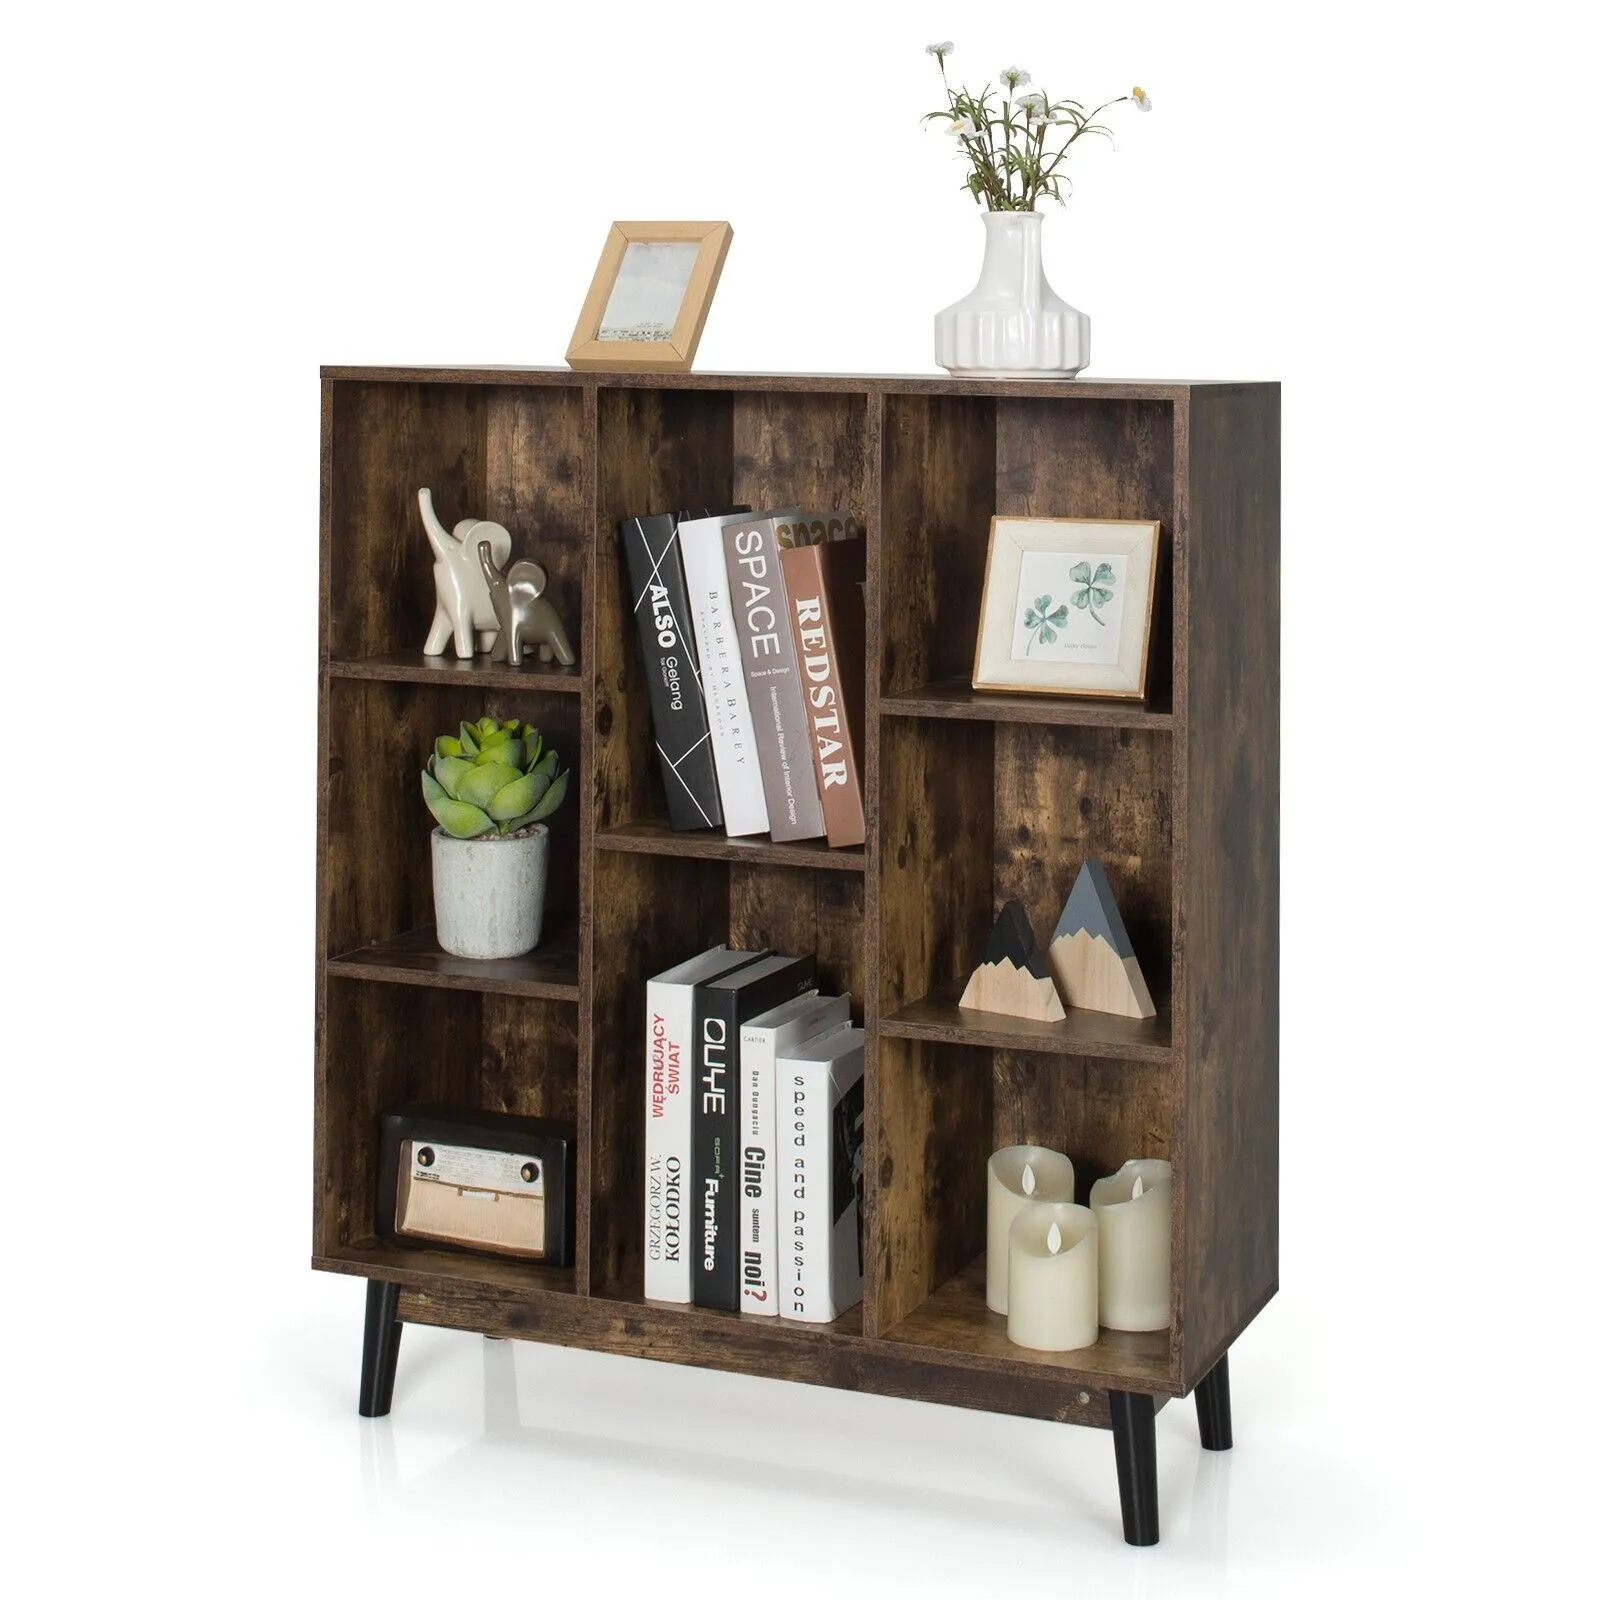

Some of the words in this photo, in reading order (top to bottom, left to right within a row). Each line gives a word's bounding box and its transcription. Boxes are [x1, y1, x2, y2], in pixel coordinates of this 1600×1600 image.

[735, 531, 780, 658] SPACE
[649, 584, 677, 648] ALSO
[666, 656, 683, 711] Gelang
[751, 669, 767, 678] Space
[772, 666, 790, 675] Design
[709, 591, 732, 688] BARBERA
[727, 698, 745, 768] BAREY
[795, 596, 848, 789] REDSTAR
[769, 686, 782, 732] International
[778, 733, 788, 761] Review
[782, 761, 789, 770] of
[783, 770, 793, 798] Interior
[788, 798, 797, 825] Design
[652, 1013, 666, 1118] WĘDRUJĄCY
[668, 1041, 681, 1095] ŚWIAT
[752, 1070, 760, 1088] Dan
[793, 1076, 805, 1146] speed
[650, 1154, 662, 1172] W.
[744, 1146, 766, 1198] Cine
[794, 1158, 805, 1199] and
[649, 1173, 662, 1261] GRZEGORZ
[665, 1156, 681, 1262] KOŁODKO
[703, 1178, 719, 1271] Furniture
[752, 1208, 760, 1243] suntem
[744, 1251, 767, 1302] noi?
[793, 1210, 805, 1312] passion
